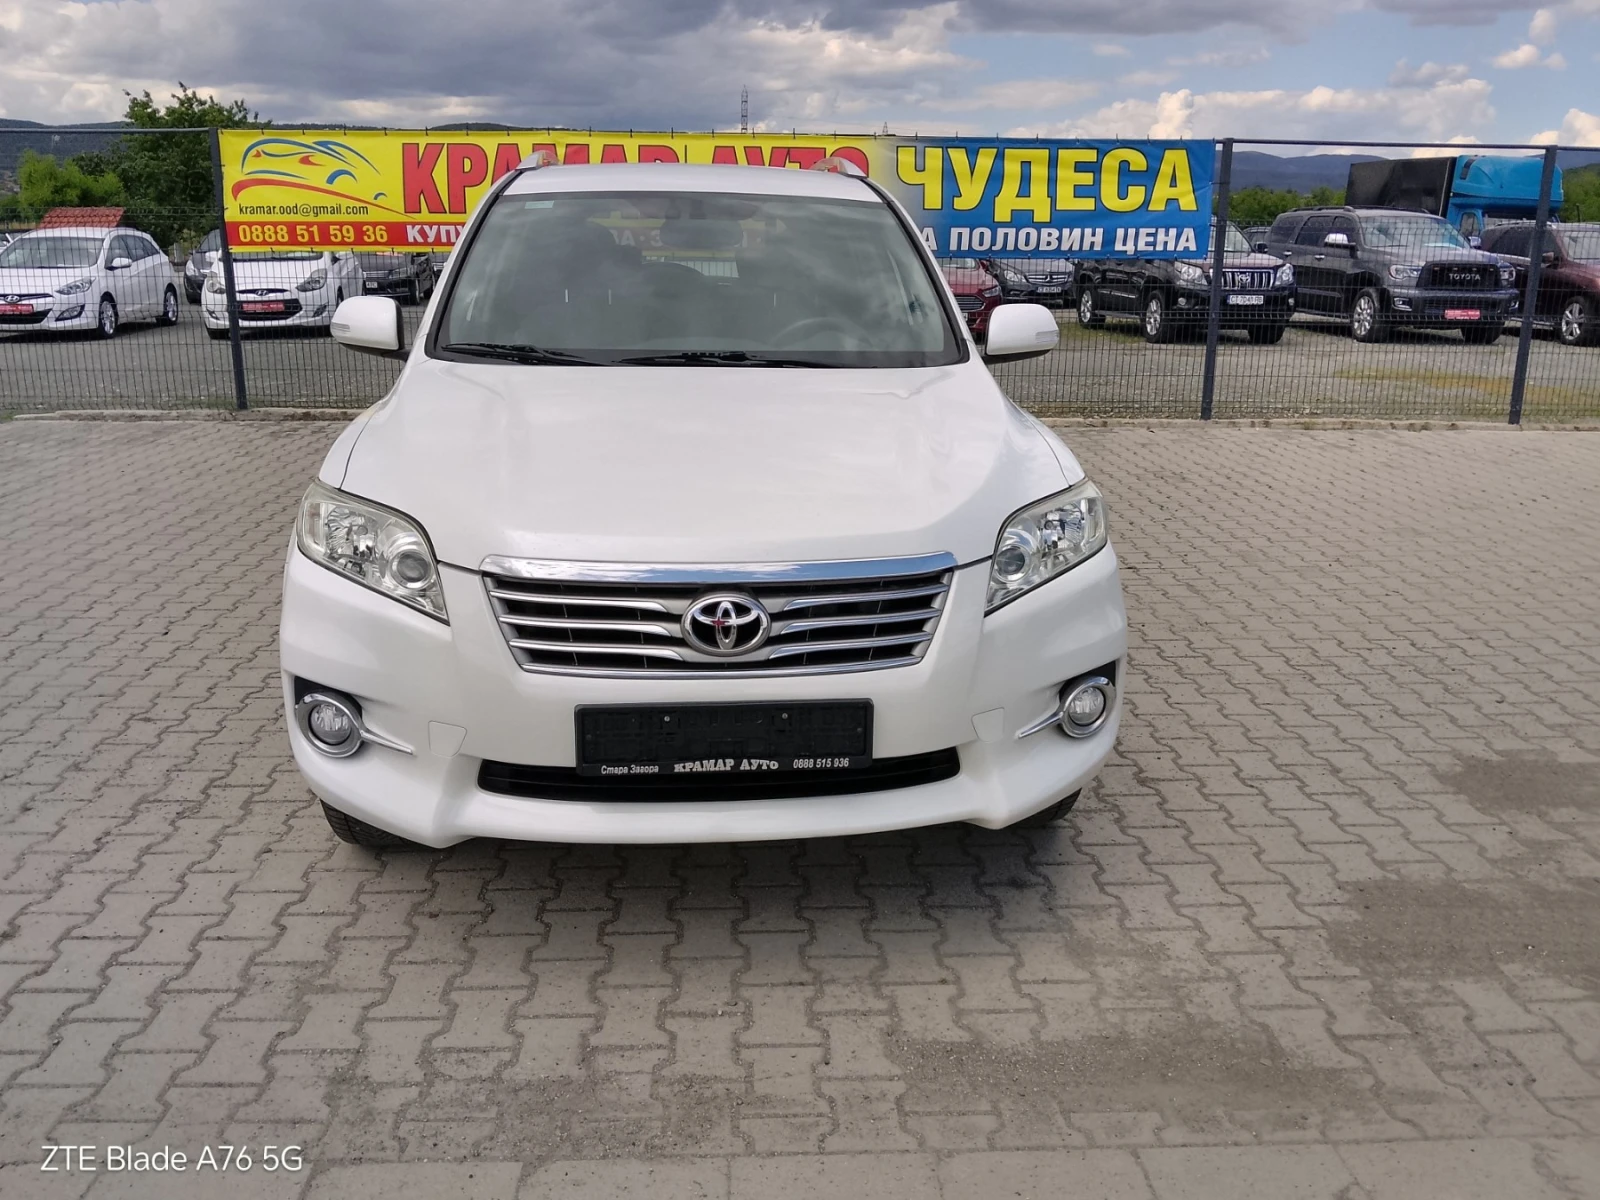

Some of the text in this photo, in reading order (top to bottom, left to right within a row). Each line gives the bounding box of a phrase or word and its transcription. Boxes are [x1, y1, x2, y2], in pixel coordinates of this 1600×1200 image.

[896, 146, 1198, 223] ЧУДЕСА
[239, 203, 369, 217] kramar.ood@gmail.com
[238, 225, 388, 243] 0888 51 59 36
[406, 225, 465, 243] КУП
[949, 227, 1104, 251] ПОЛОВИН
[1114, 227, 1197, 256] ЦЕНА
[601, 765, 629, 775] Стара
[629, 764, 659, 774] Загора
[674, 759, 735, 772] КРАМАР
[793, 758, 850, 769] 0888 515 936
